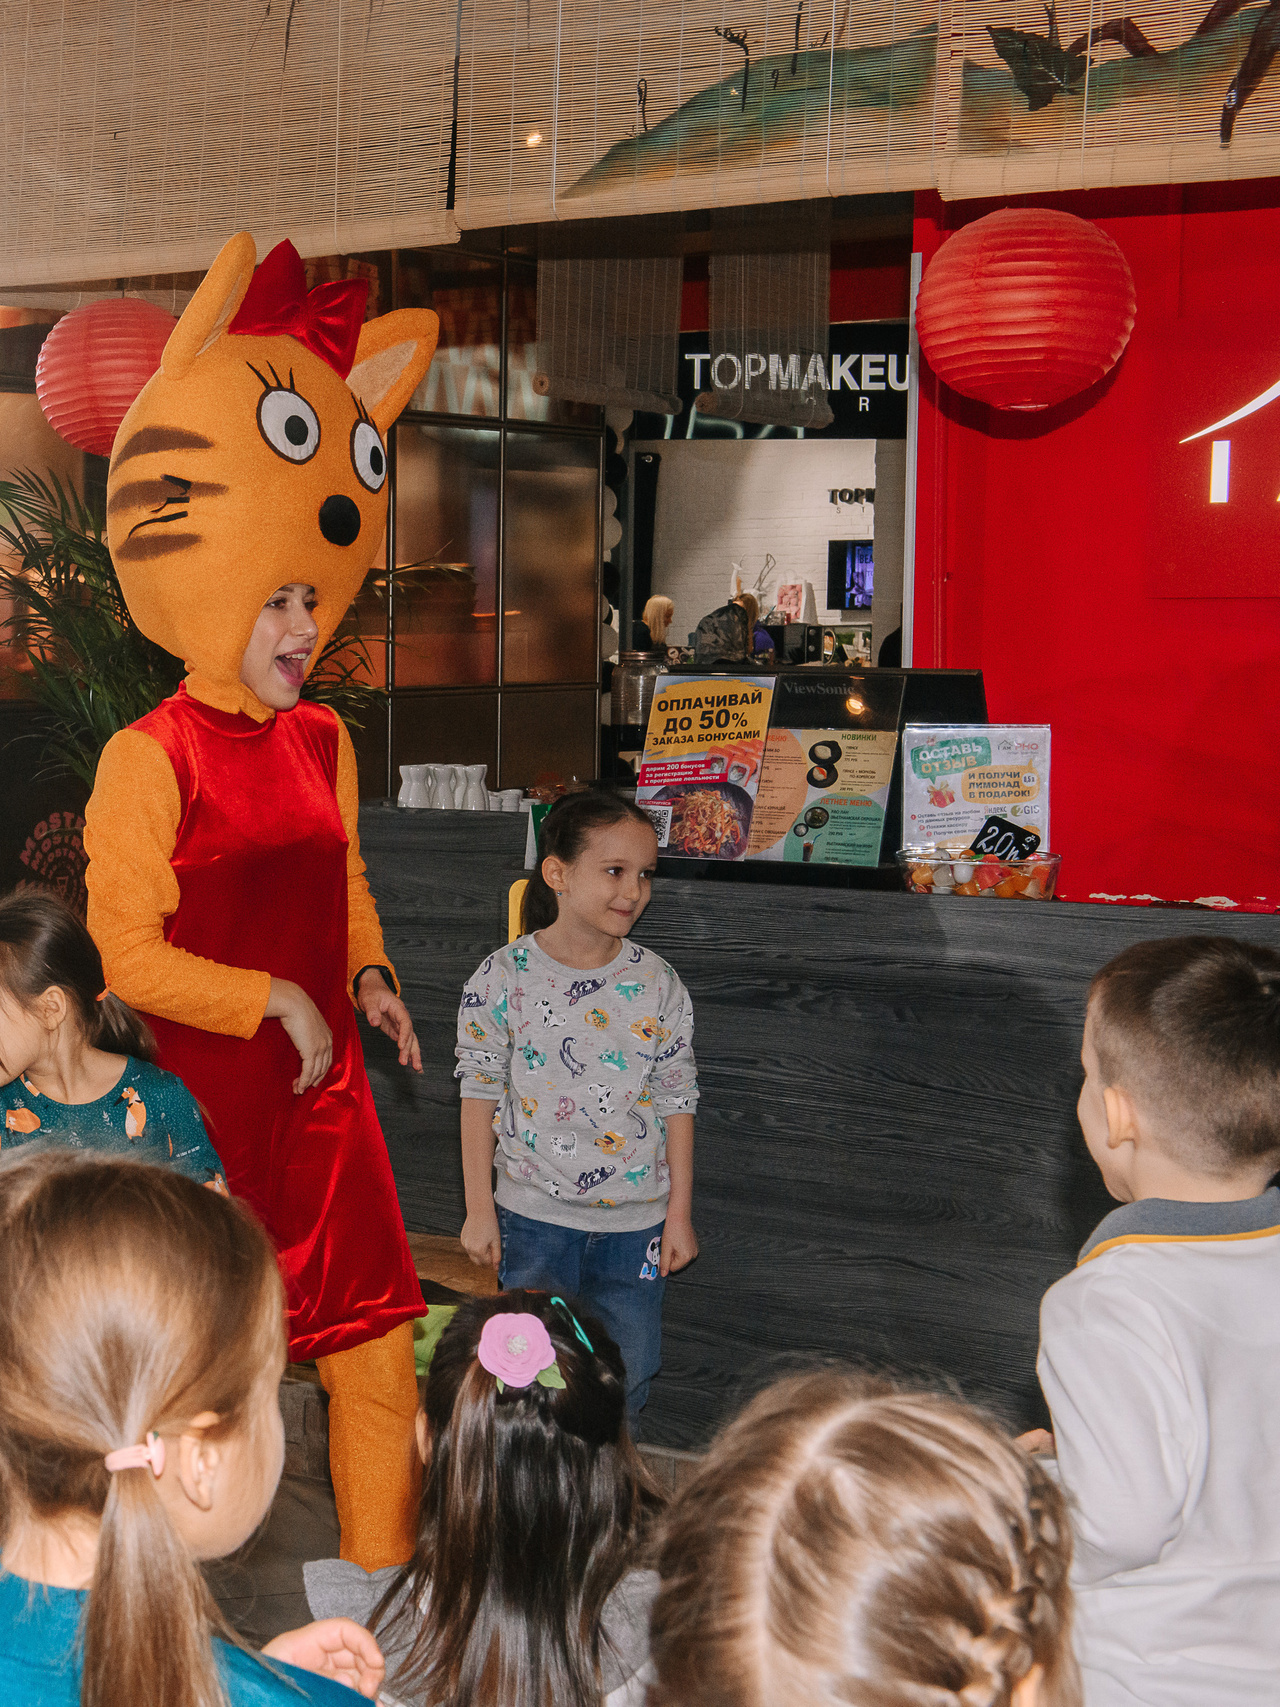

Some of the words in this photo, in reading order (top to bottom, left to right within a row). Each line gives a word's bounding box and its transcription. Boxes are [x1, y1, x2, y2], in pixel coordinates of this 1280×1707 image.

[783, 681, 855, 695] ViewSonic
[657, 689, 763, 712] ОПЛАЧИВАЙ
[663, 717, 692, 735] ДО
[699, 709, 748, 729] 50%
[652, 735, 694, 746] ЗАКАЗА
[697, 730, 761, 742] БОНУСАМИ
[841, 733, 877, 741] НОВИНКИ
[919, 742, 983, 761] ОСТАВЬ
[921, 755, 977, 773] ОТЗЫВ
[978, 771, 1020, 780] ПОЛУЧИ
[968, 781, 1020, 789] ЛИМОНАД
[978, 789, 1030, 799] ПОДАРОК!
[819, 798, 847, 806] ЛЕТНЕЕ
[849, 799, 873, 807] МЕНЮ
